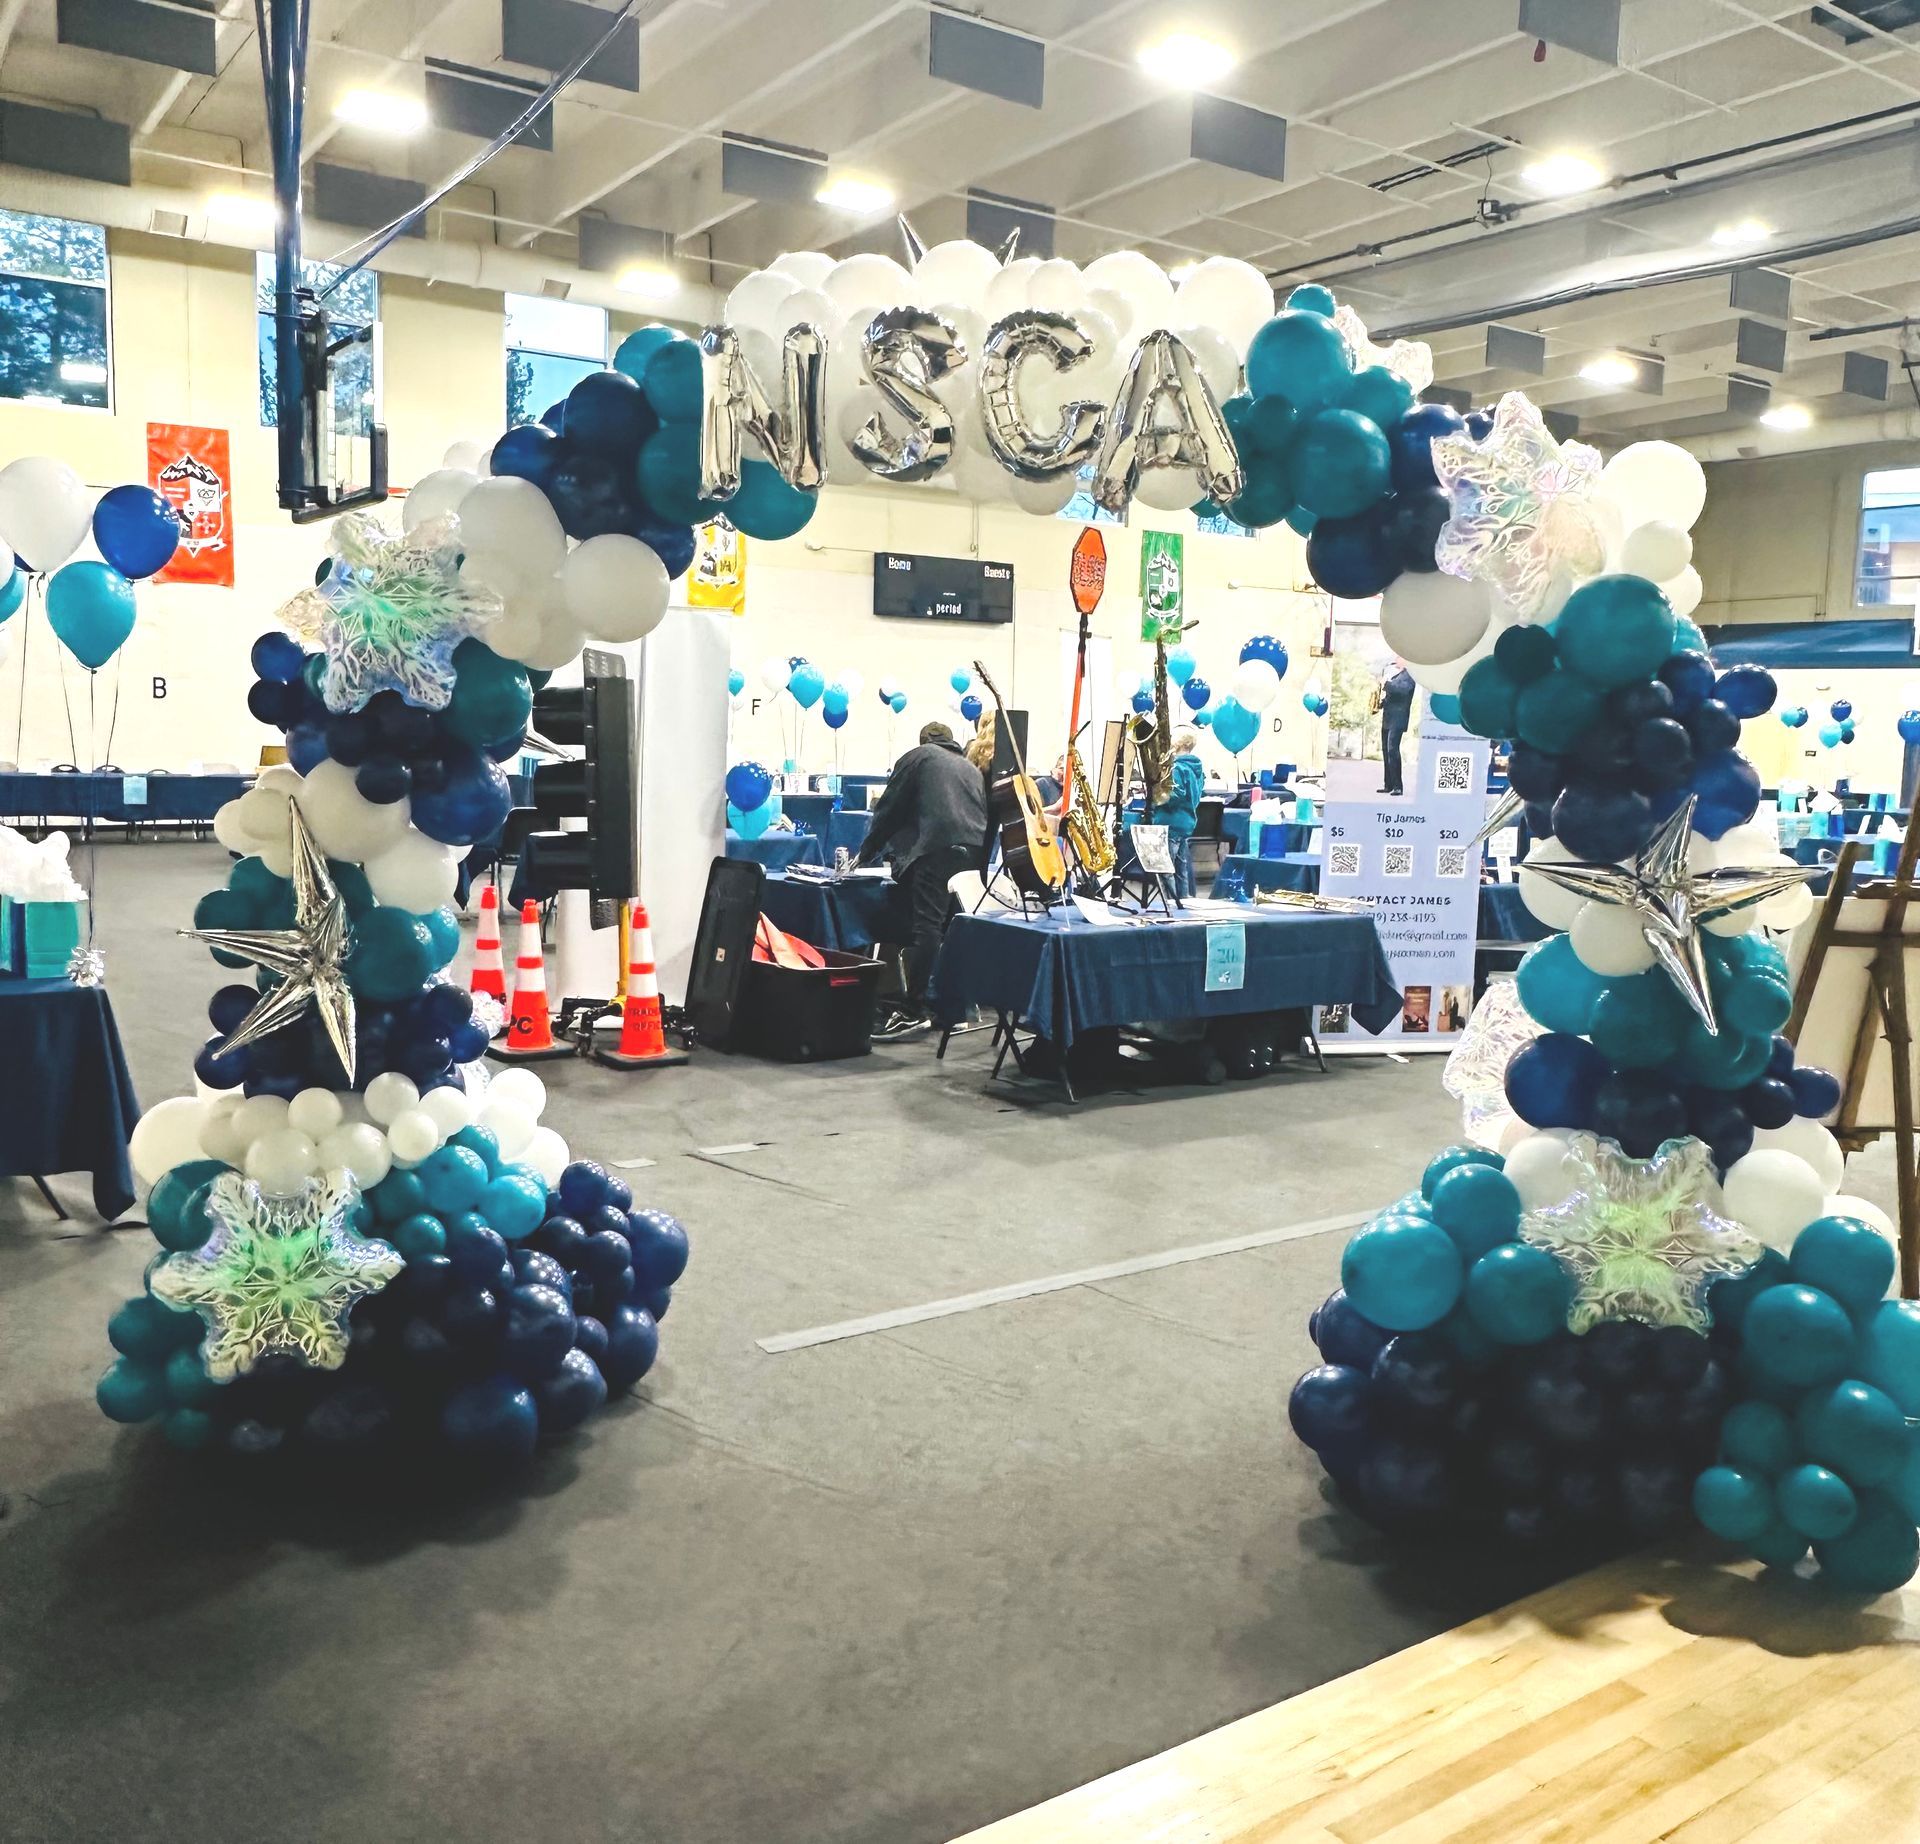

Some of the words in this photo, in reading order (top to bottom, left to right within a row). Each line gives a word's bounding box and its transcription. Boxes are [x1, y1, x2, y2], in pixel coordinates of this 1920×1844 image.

[936, 603, 962, 615] period
[152, 676, 167, 699] B
[752, 698, 762, 716] F
[1273, 717, 1283, 733] D
[1376, 812, 1392, 823] Tip
[1393, 813, 1426, 823] James
[1330, 826, 1345, 837] $5
[1384, 828, 1404, 838] $10
[1439, 829, 1459, 839] $20
[1410, 896, 1452, 906] JAMES
